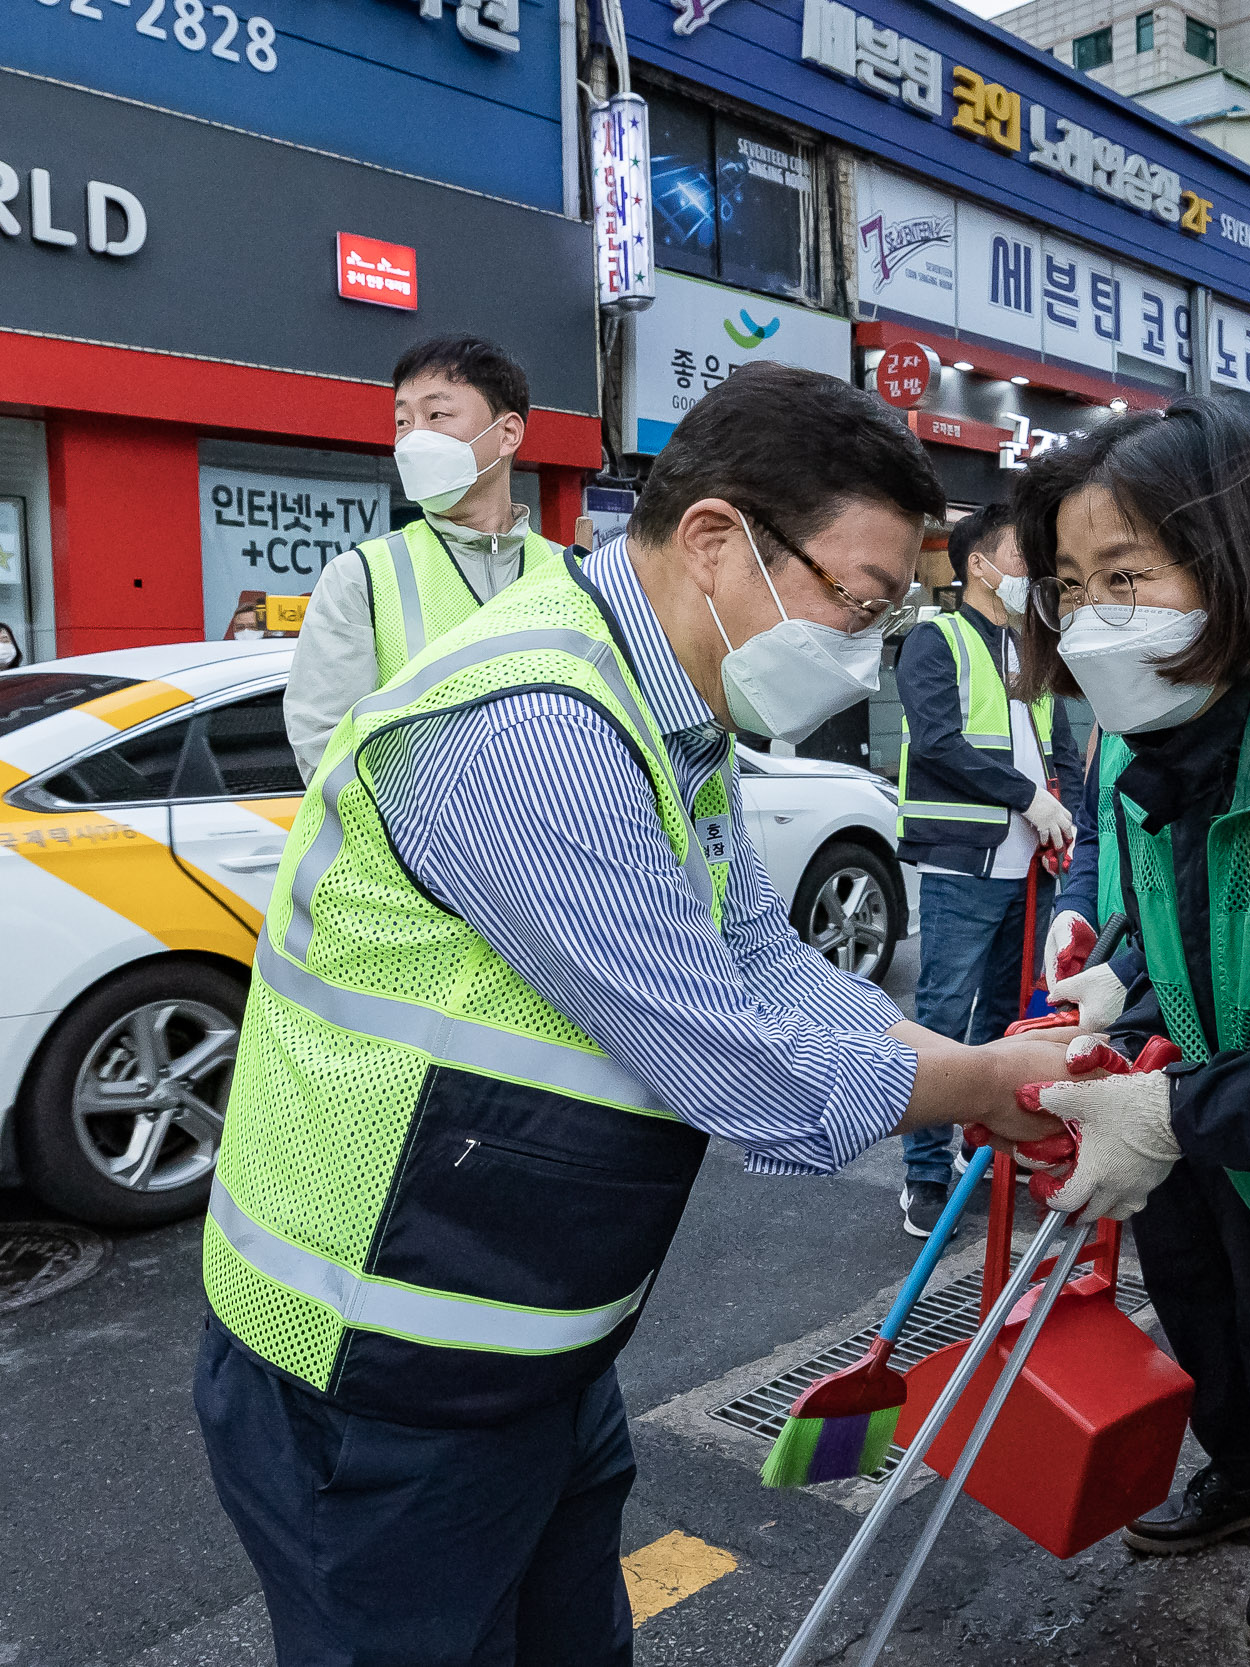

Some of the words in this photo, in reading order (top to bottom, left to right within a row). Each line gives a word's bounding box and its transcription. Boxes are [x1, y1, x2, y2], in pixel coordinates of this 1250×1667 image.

[953, 65, 1021, 152] 코인
[1029, 103, 1183, 223] 노래연습장
[1180, 189, 1214, 235] 2F
[989, 233, 1122, 343] 세븐틴
[883, 377, 923, 398] 김밥
[210, 483, 379, 534] 인터넷+TV
